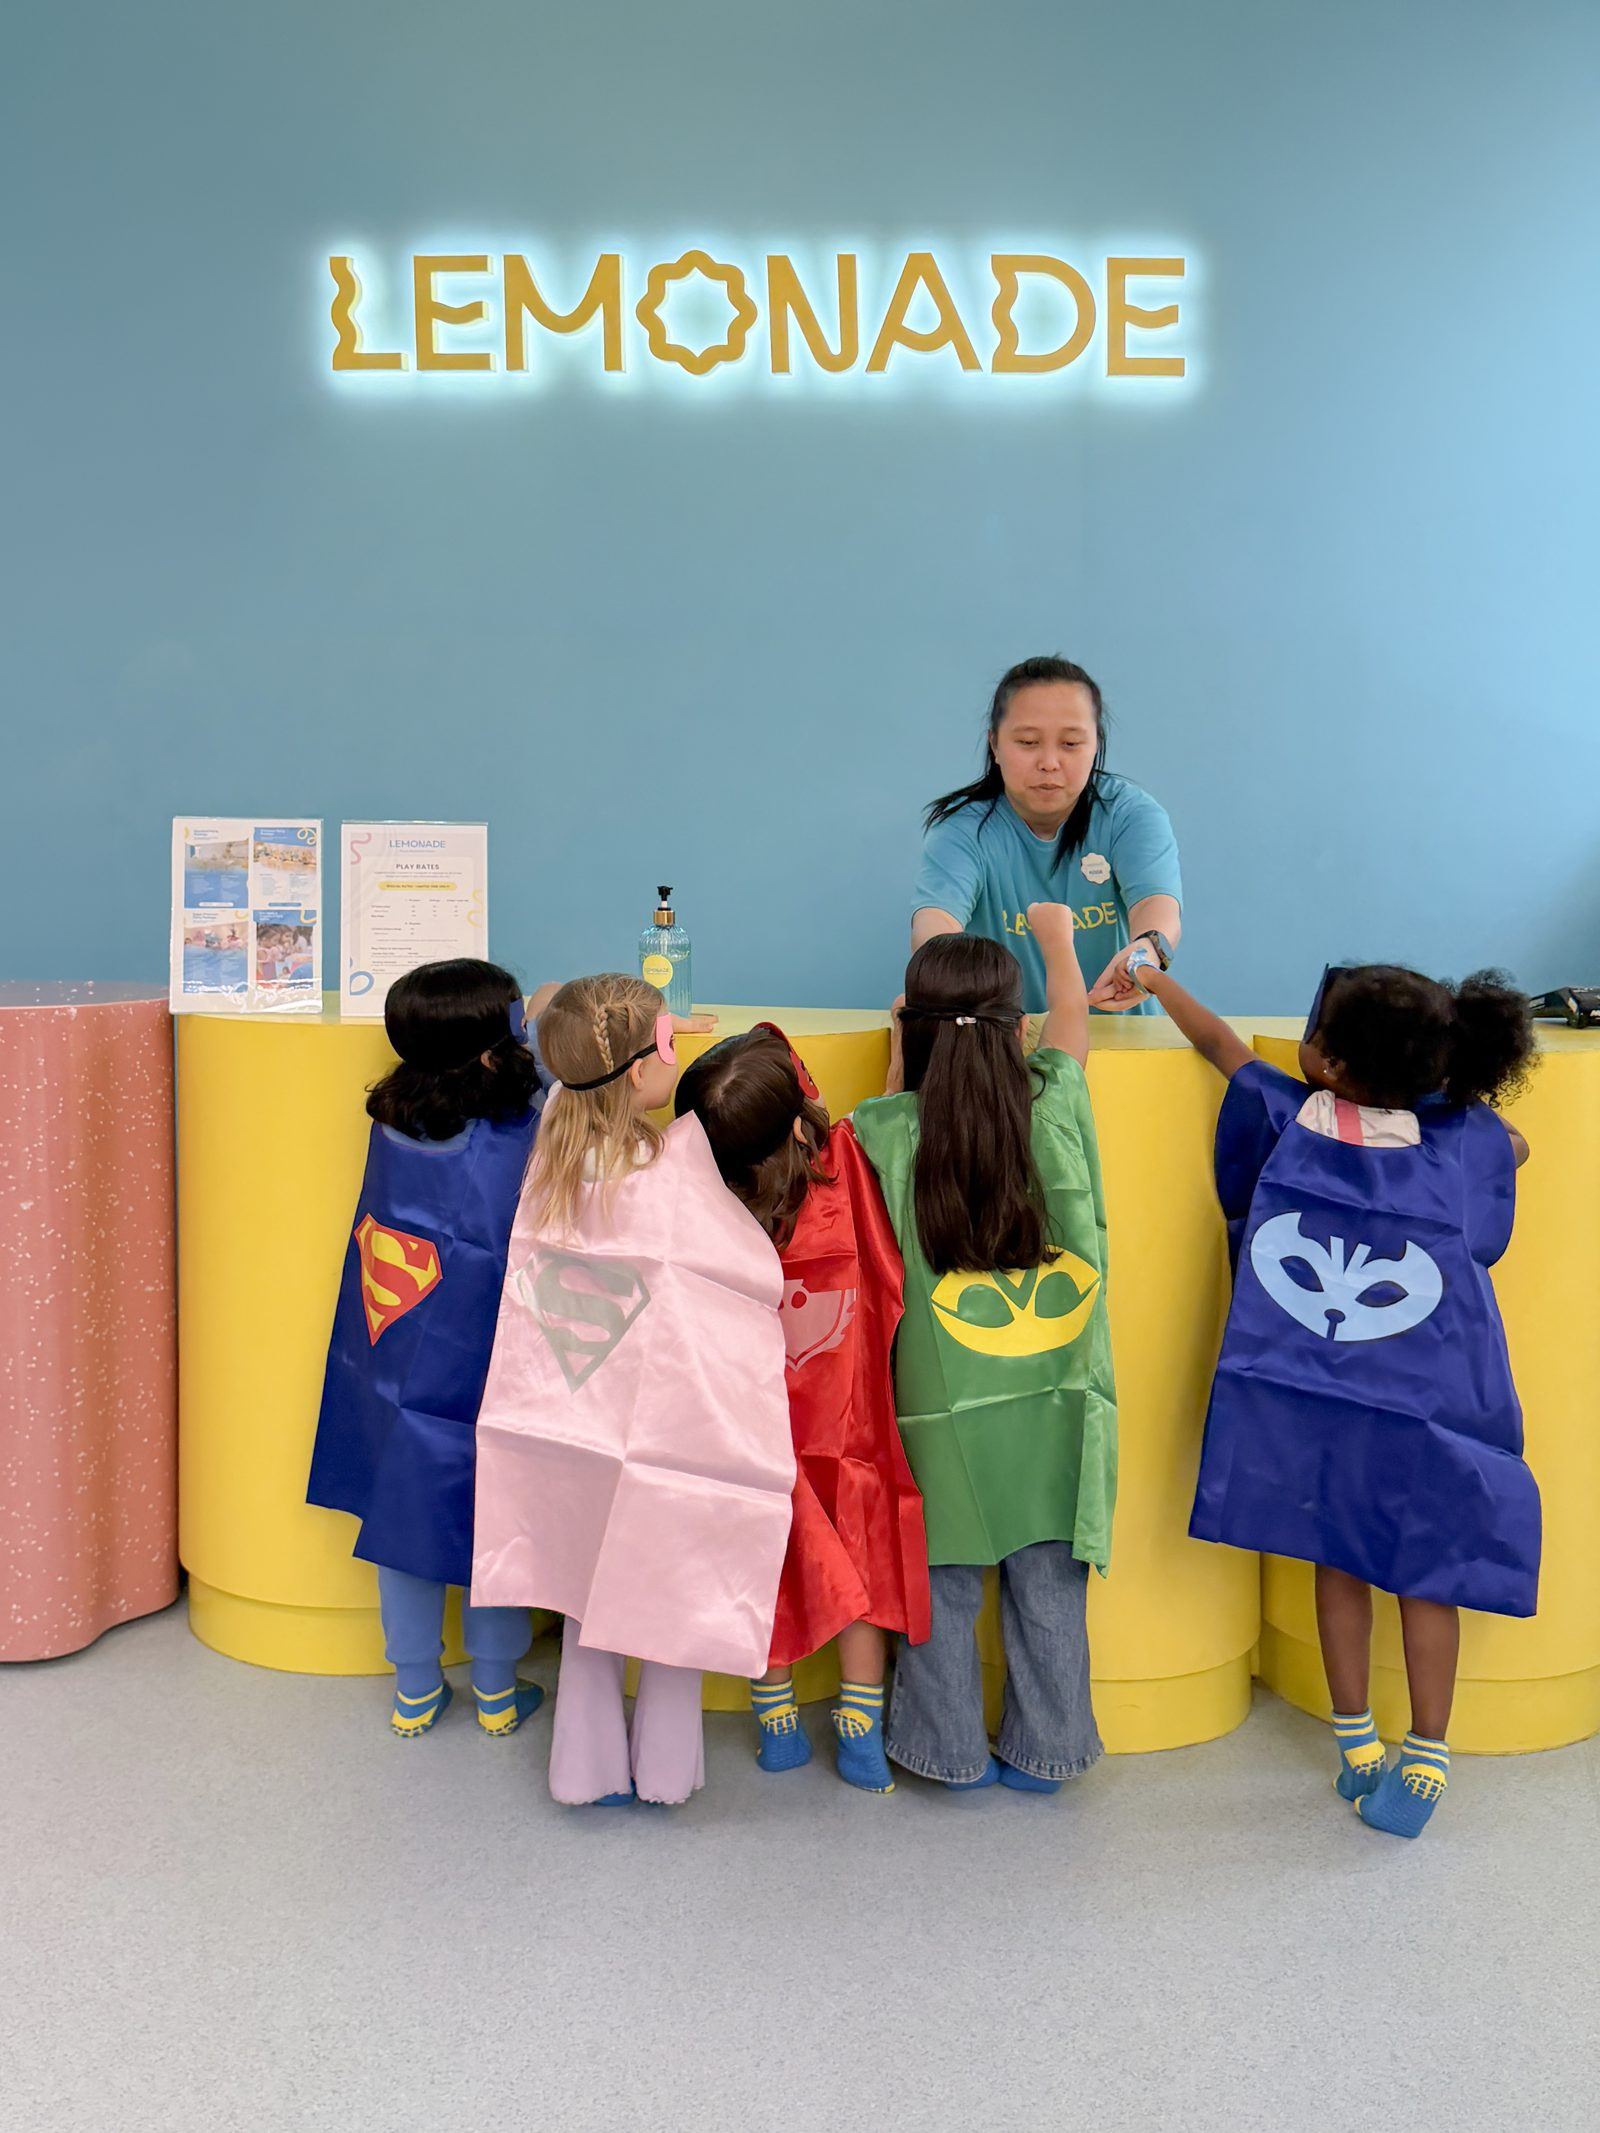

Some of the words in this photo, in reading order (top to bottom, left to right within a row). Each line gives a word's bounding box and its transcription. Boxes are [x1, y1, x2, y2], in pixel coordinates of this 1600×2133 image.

[329, 248, 1187, 378] LEMONADE
[389, 839, 447, 848] LEMONADE
[1001, 901, 1118, 936] LEADE
